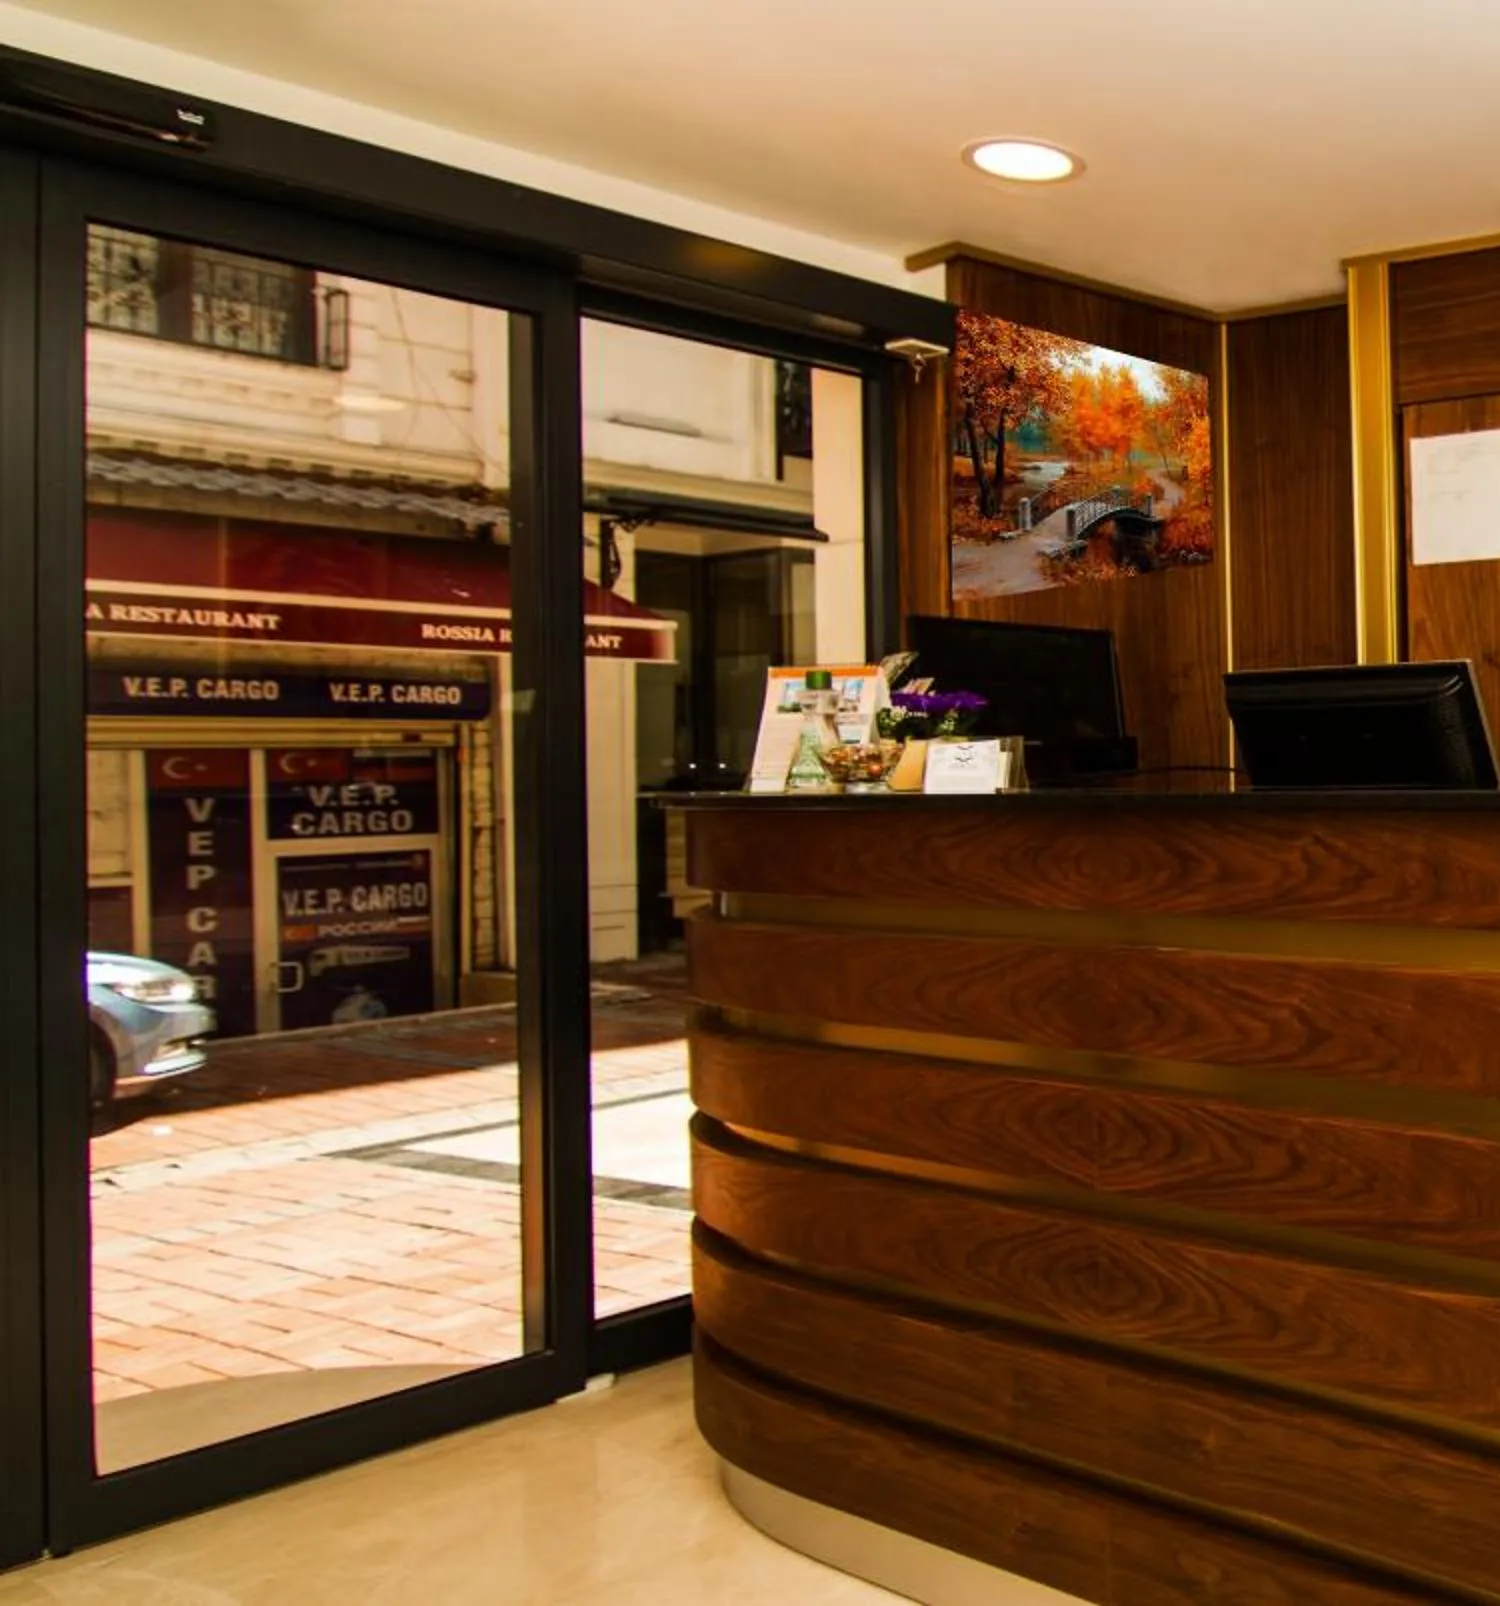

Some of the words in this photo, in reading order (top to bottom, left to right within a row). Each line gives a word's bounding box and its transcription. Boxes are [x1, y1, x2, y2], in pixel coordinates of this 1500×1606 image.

[110, 604, 282, 630] RESTAURANT
[421, 623, 495, 643] ROSSIA
[122, 676, 188, 699] V.E.P.
[196, 679, 280, 700] CARGO
[329, 682, 385, 703] V.E.P.
[391, 685, 462, 705] CARGO
[308, 783, 400, 807] V.E.P.
[292, 809, 414, 836] CARGO
[282, 886, 344, 916] V.E.P.
[352, 881, 428, 913] CARGO
